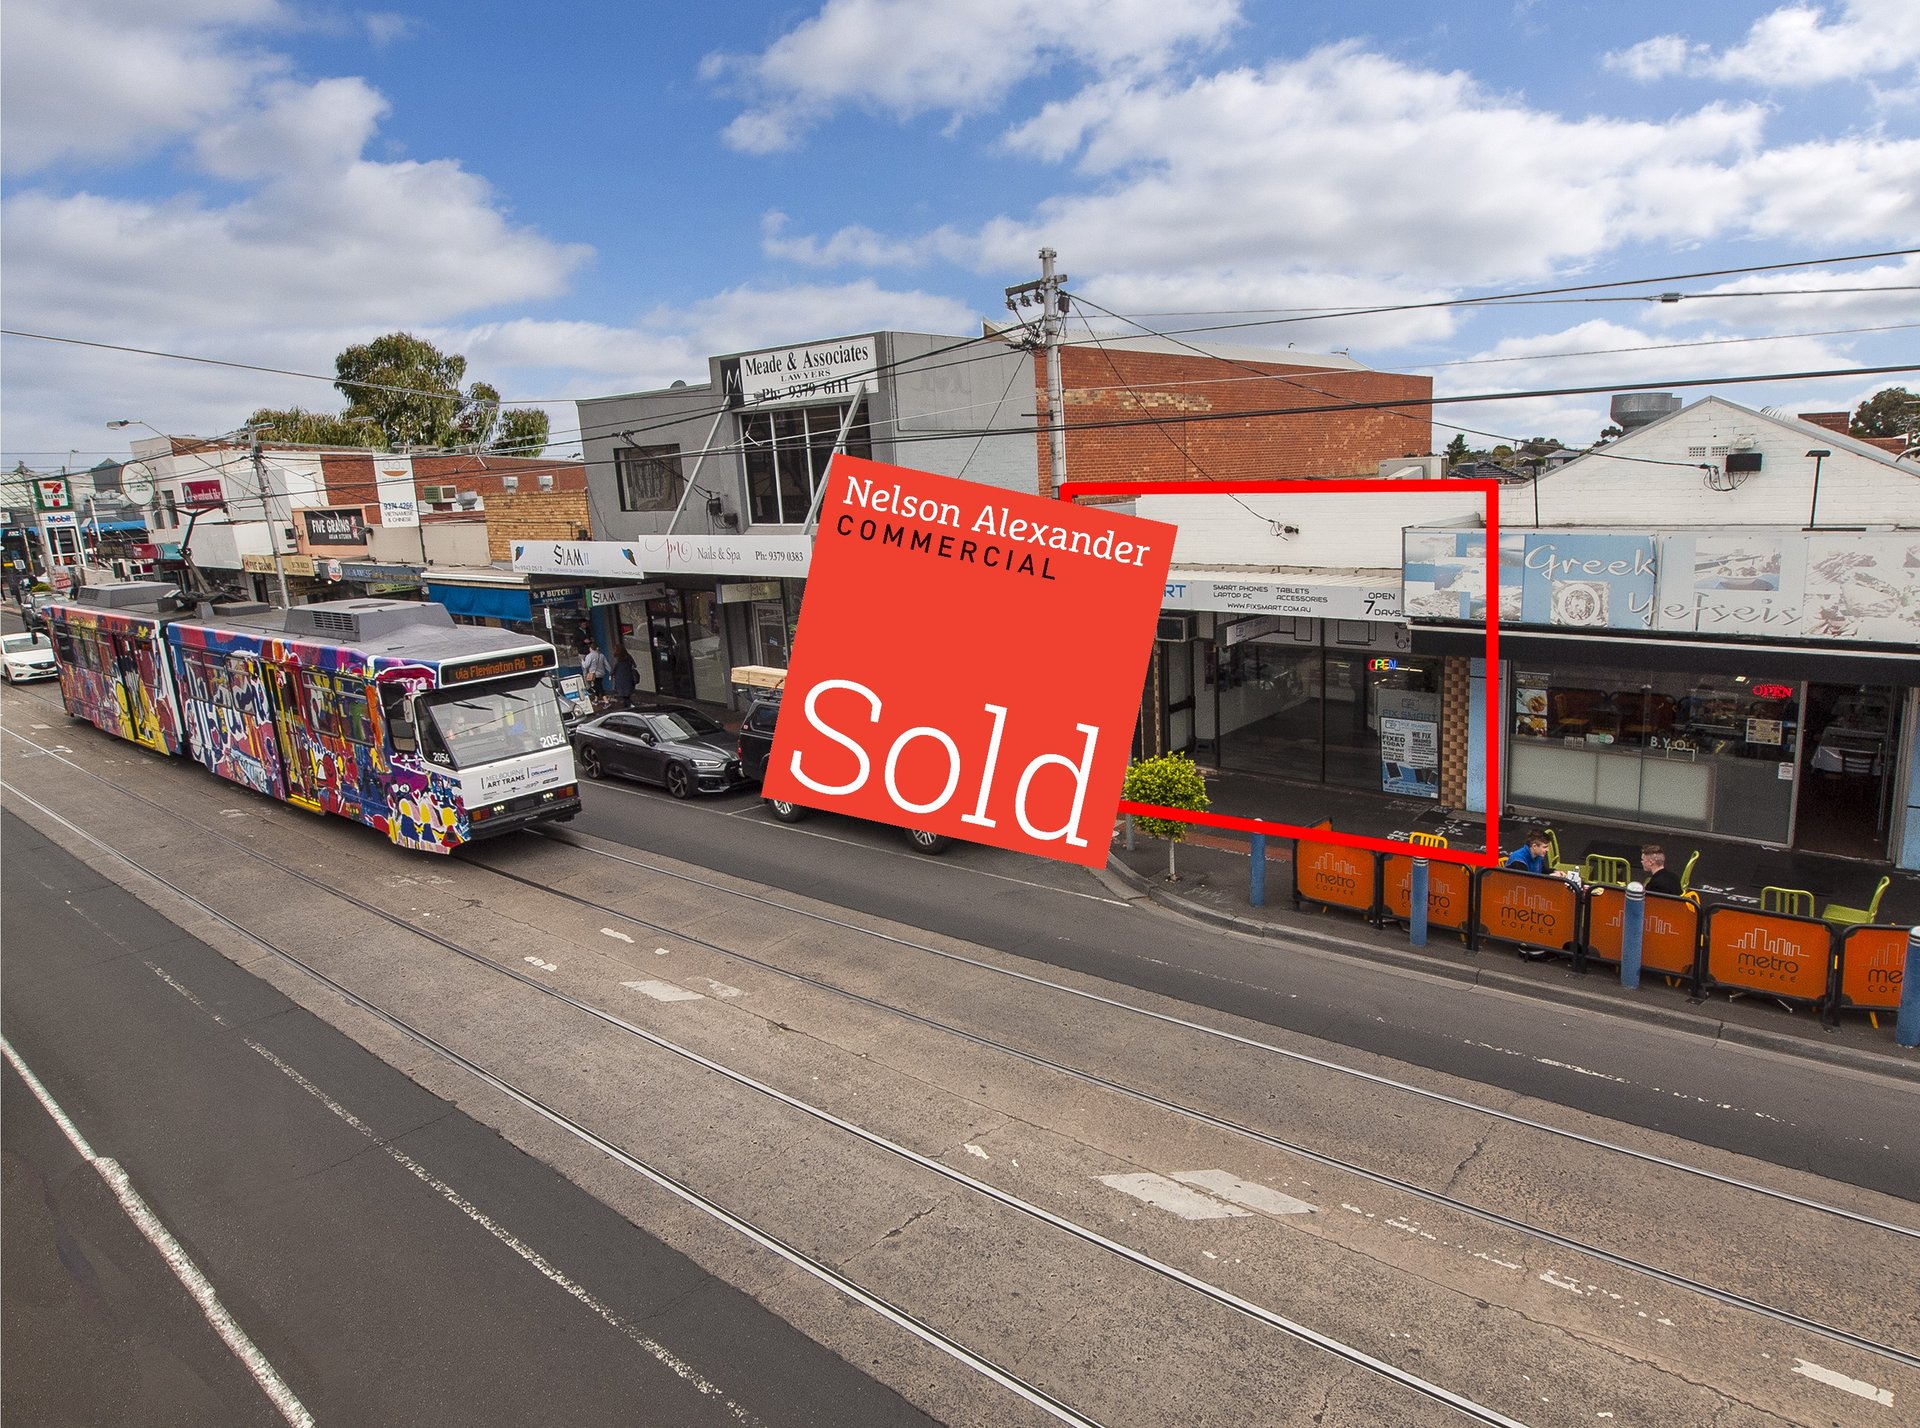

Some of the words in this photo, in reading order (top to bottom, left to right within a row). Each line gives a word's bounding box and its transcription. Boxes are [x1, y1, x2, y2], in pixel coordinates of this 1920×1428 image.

[745, 354, 782, 377] Meade
[786, 351, 797, 371] &
[803, 344, 869, 370] Associates
[780, 369, 832, 384] LAWYERS
[761, 387, 781, 400] Ph:
[788, 381, 816, 399] 9379
[824, 377, 850, 396] 6111
[47, 514, 71, 524] Mobil
[312, 519, 326, 533] FIVE
[327, 518, 351, 533] GRAINS
[553, 544, 584, 566] SIAM
[697, 546, 717, 560] Nails
[718, 547, 726, 560] &
[726, 547, 742, 564] Spa
[755, 550, 767, 560] Ph:
[769, 550, 786, 562] 9379
[787, 551, 804, 562] 0383
[1525, 543, 1658, 581] Greek
[540, 590, 546, 599] P
[1213, 584, 1238, 593] SMART
[1239, 585, 1269, 594] PHONES
[1276, 586, 1310, 595] TABLETS
[592, 591, 617, 604] SIAM
[1213, 592, 1241, 600] LAPTOP
[1276, 594, 1329, 604] ACCESSORIES
[1368, 591, 1396, 601] OPEN
[1227, 602, 1312, 613] WWW.FIXSMART.COM.AU
[1363, 600, 1376, 615] 7
[1374, 608, 1401, 617] DAYS
[455, 669, 470, 680] via
[470, 661, 514, 678] Flemington
[514, 657, 526, 671] Rd
[532, 655, 544, 667] 59
[1368, 658, 1398, 671] OPEN
[1753, 685, 1793, 698] OPEN
[540, 733, 566, 748] 2054
[1382, 734, 1406, 743] FIXED
[1411, 731, 1421, 739] WE
[1383, 740, 1405, 748] TODAY
[433, 752, 451, 763] 2054
[485, 767, 525, 781] MELBOURNE
[487, 779, 501, 789] ART
[502, 774, 526, 785] TRAMS
[1315, 871, 1356, 889] metro
[1571, 872, 1576, 880] 7
[1316, 884, 1355, 896] COFFEE
[1402, 889, 1451, 909] mtro
[1402, 901, 1450, 917] CFEE
[1501, 905, 1556, 927] metro
[1501, 919, 1554, 936] COFFEE
[1738, 952, 1799, 974] metro
[1738, 966, 1799, 983] COFFEE
[1867, 984, 1899, 993] COF
